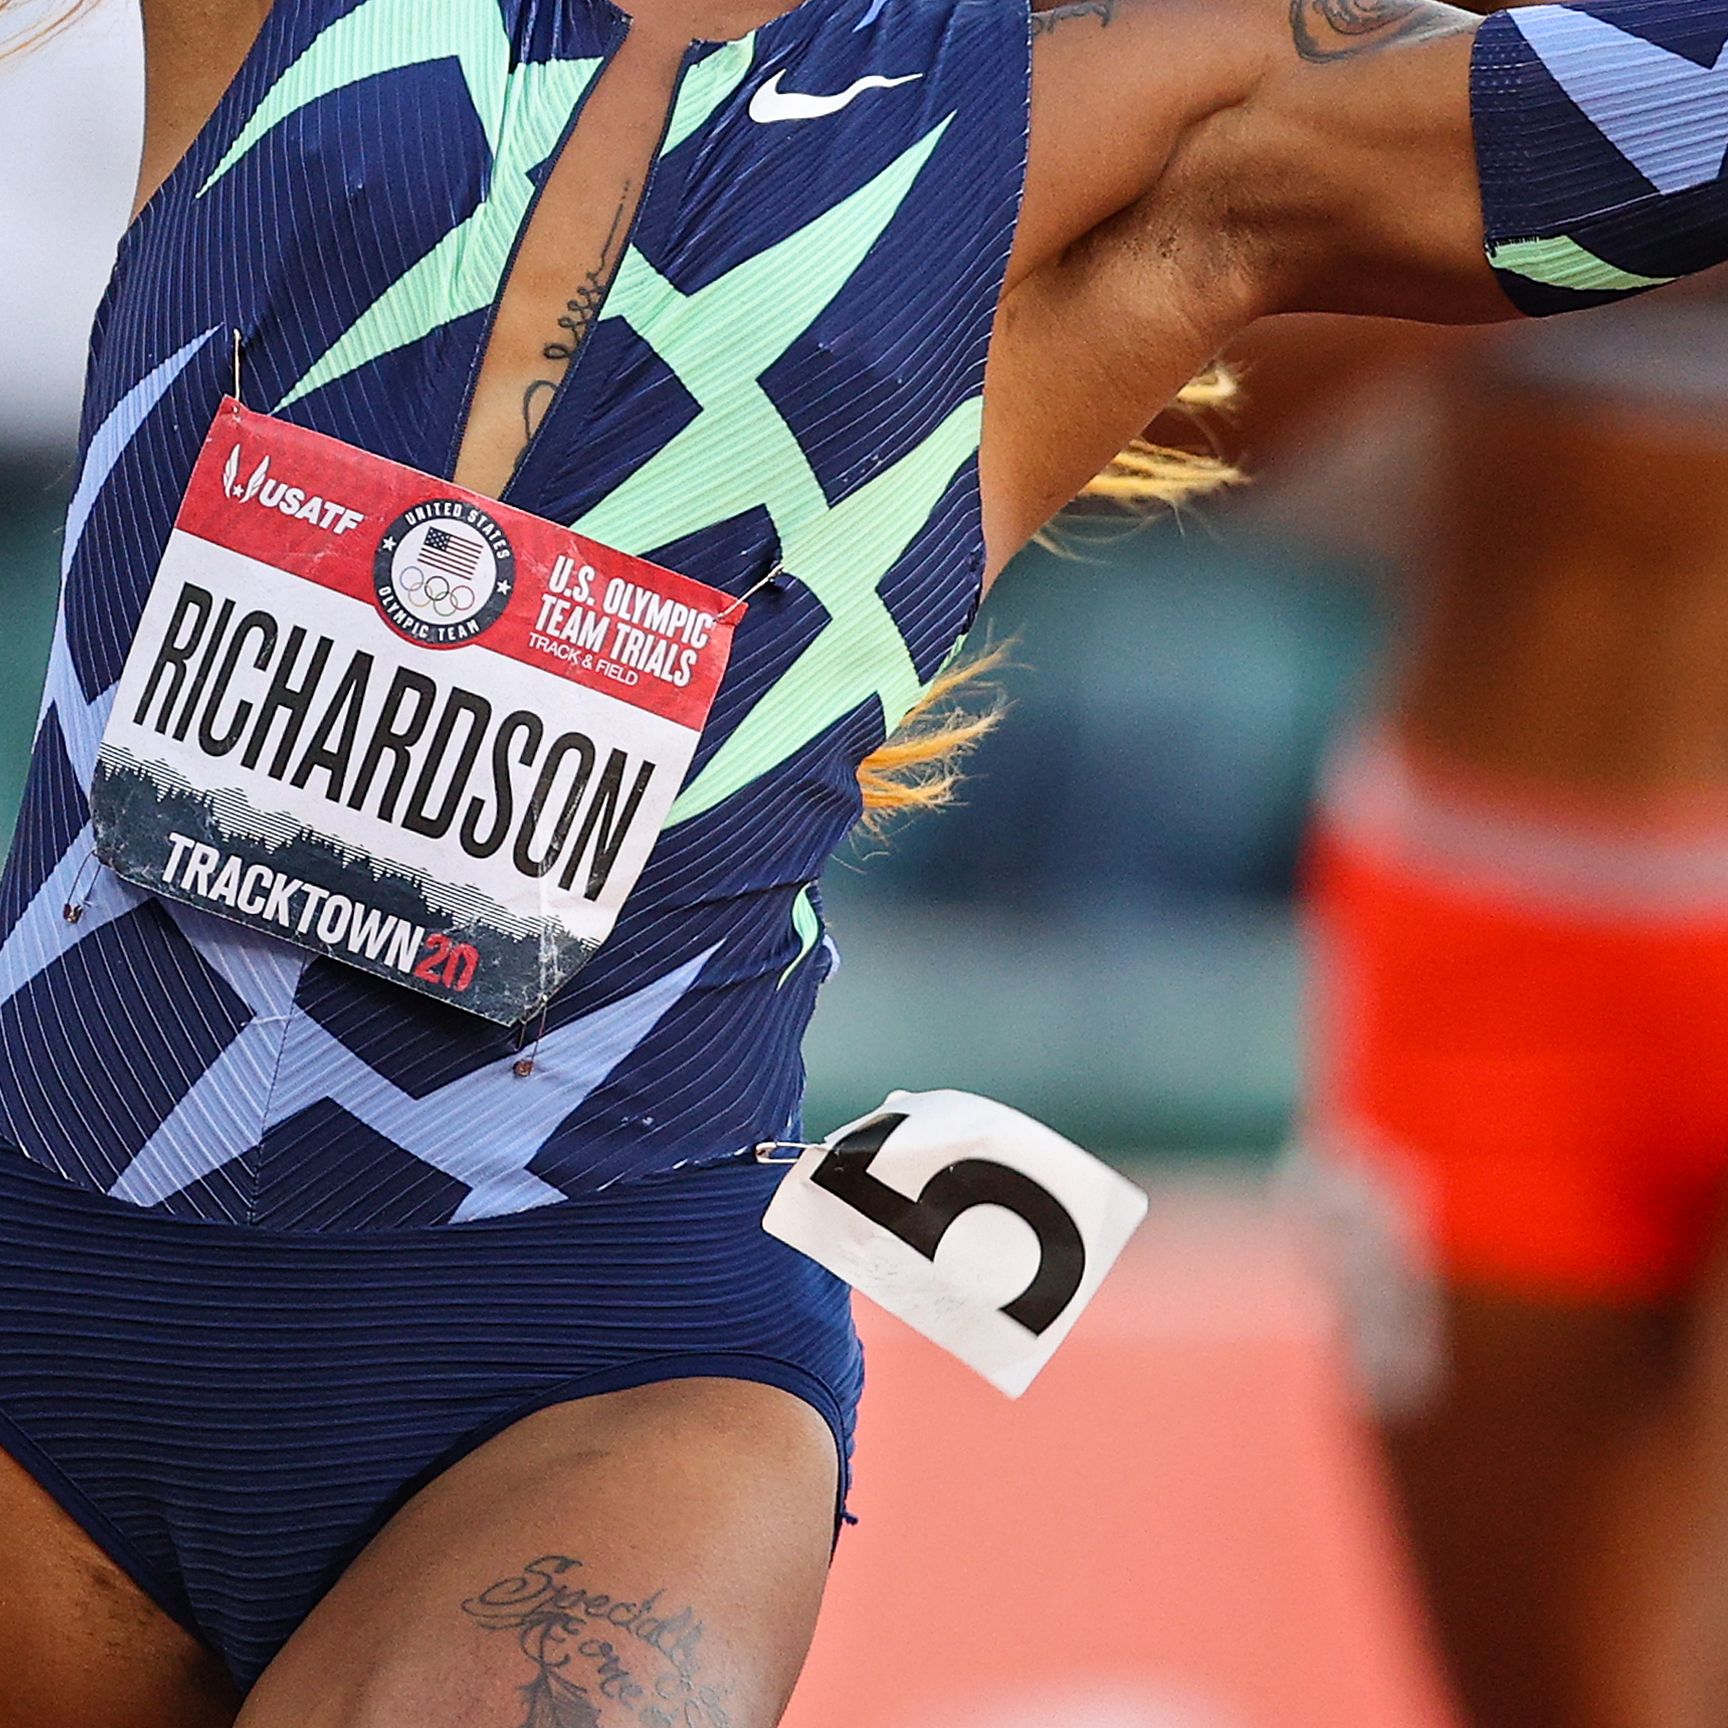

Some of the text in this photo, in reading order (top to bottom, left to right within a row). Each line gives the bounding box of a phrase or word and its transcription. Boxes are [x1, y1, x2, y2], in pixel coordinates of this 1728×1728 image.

[259, 479, 364, 534] USATF
[404, 502, 510, 559] UNITED STATES
[378, 586, 480, 641] OLYMPIC TEAM
[548, 554, 714, 650] U.S. OLYMPIC
[528, 632, 639, 687] TRACK & FIELD
[535, 593, 698, 688] TEAM TRIALS
[132, 582, 656, 902] RICHARDSON
[809, 1112, 1087, 1337] 5
